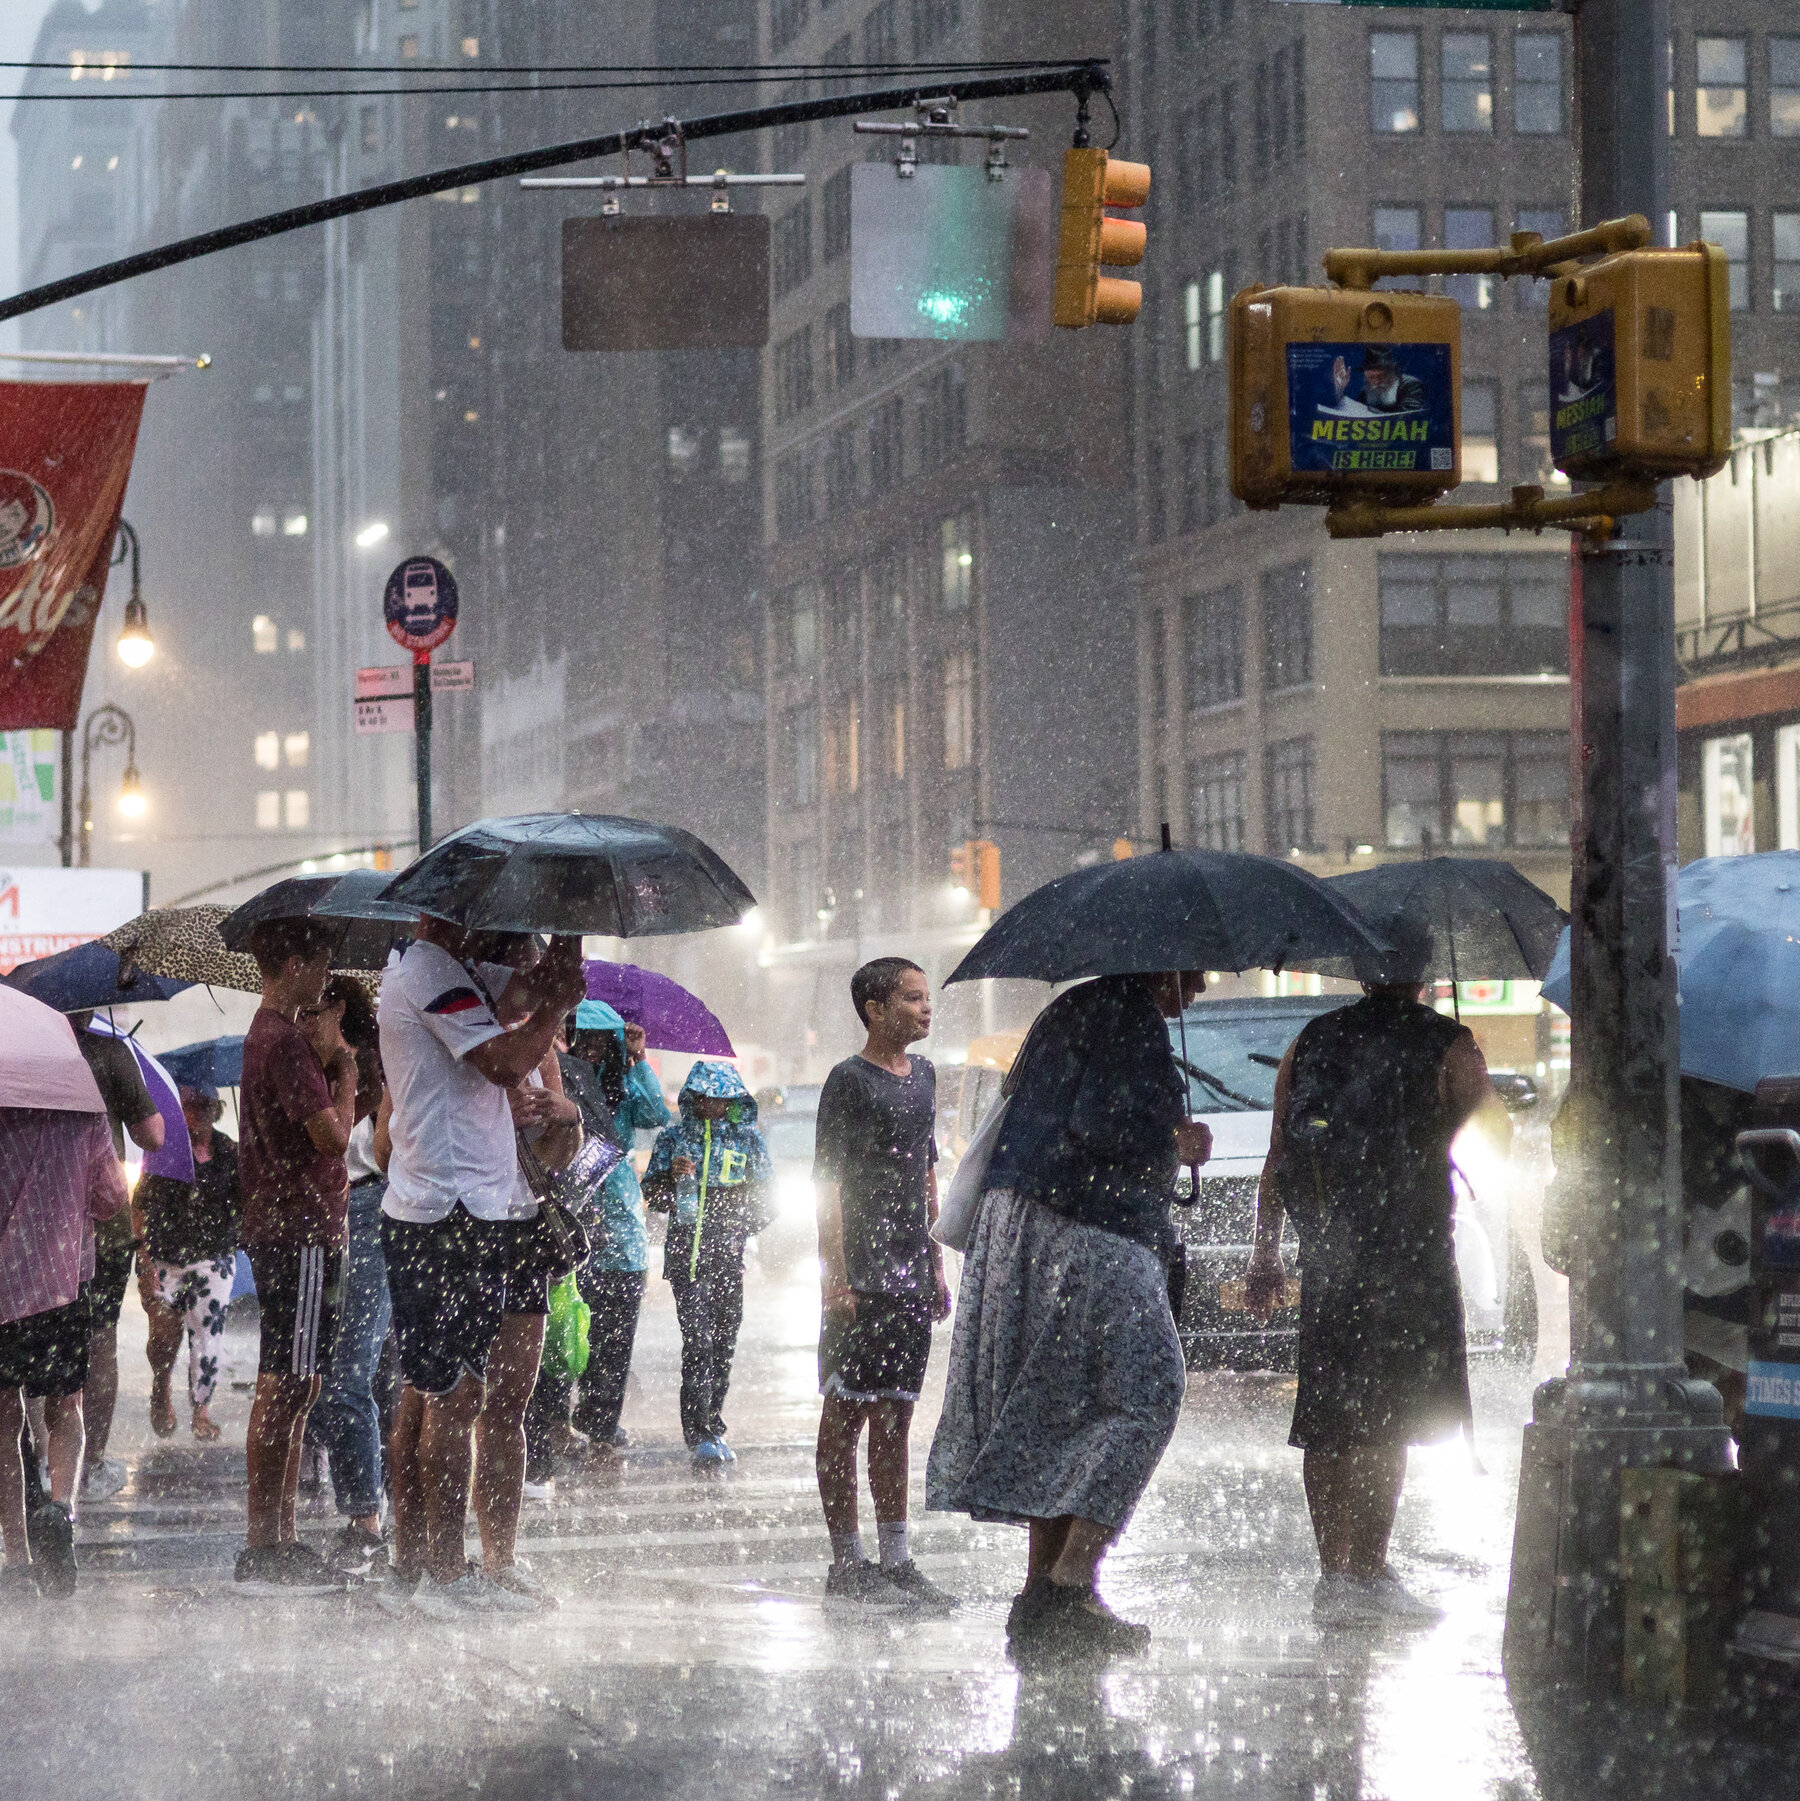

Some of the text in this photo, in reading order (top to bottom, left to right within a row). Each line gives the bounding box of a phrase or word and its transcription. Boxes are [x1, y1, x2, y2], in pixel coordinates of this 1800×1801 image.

[1311, 420, 1429, 441] MESSIAH
[1335, 451, 1415, 468] IS HERE!
[1750, 1375, 1791, 1405] TIMES
